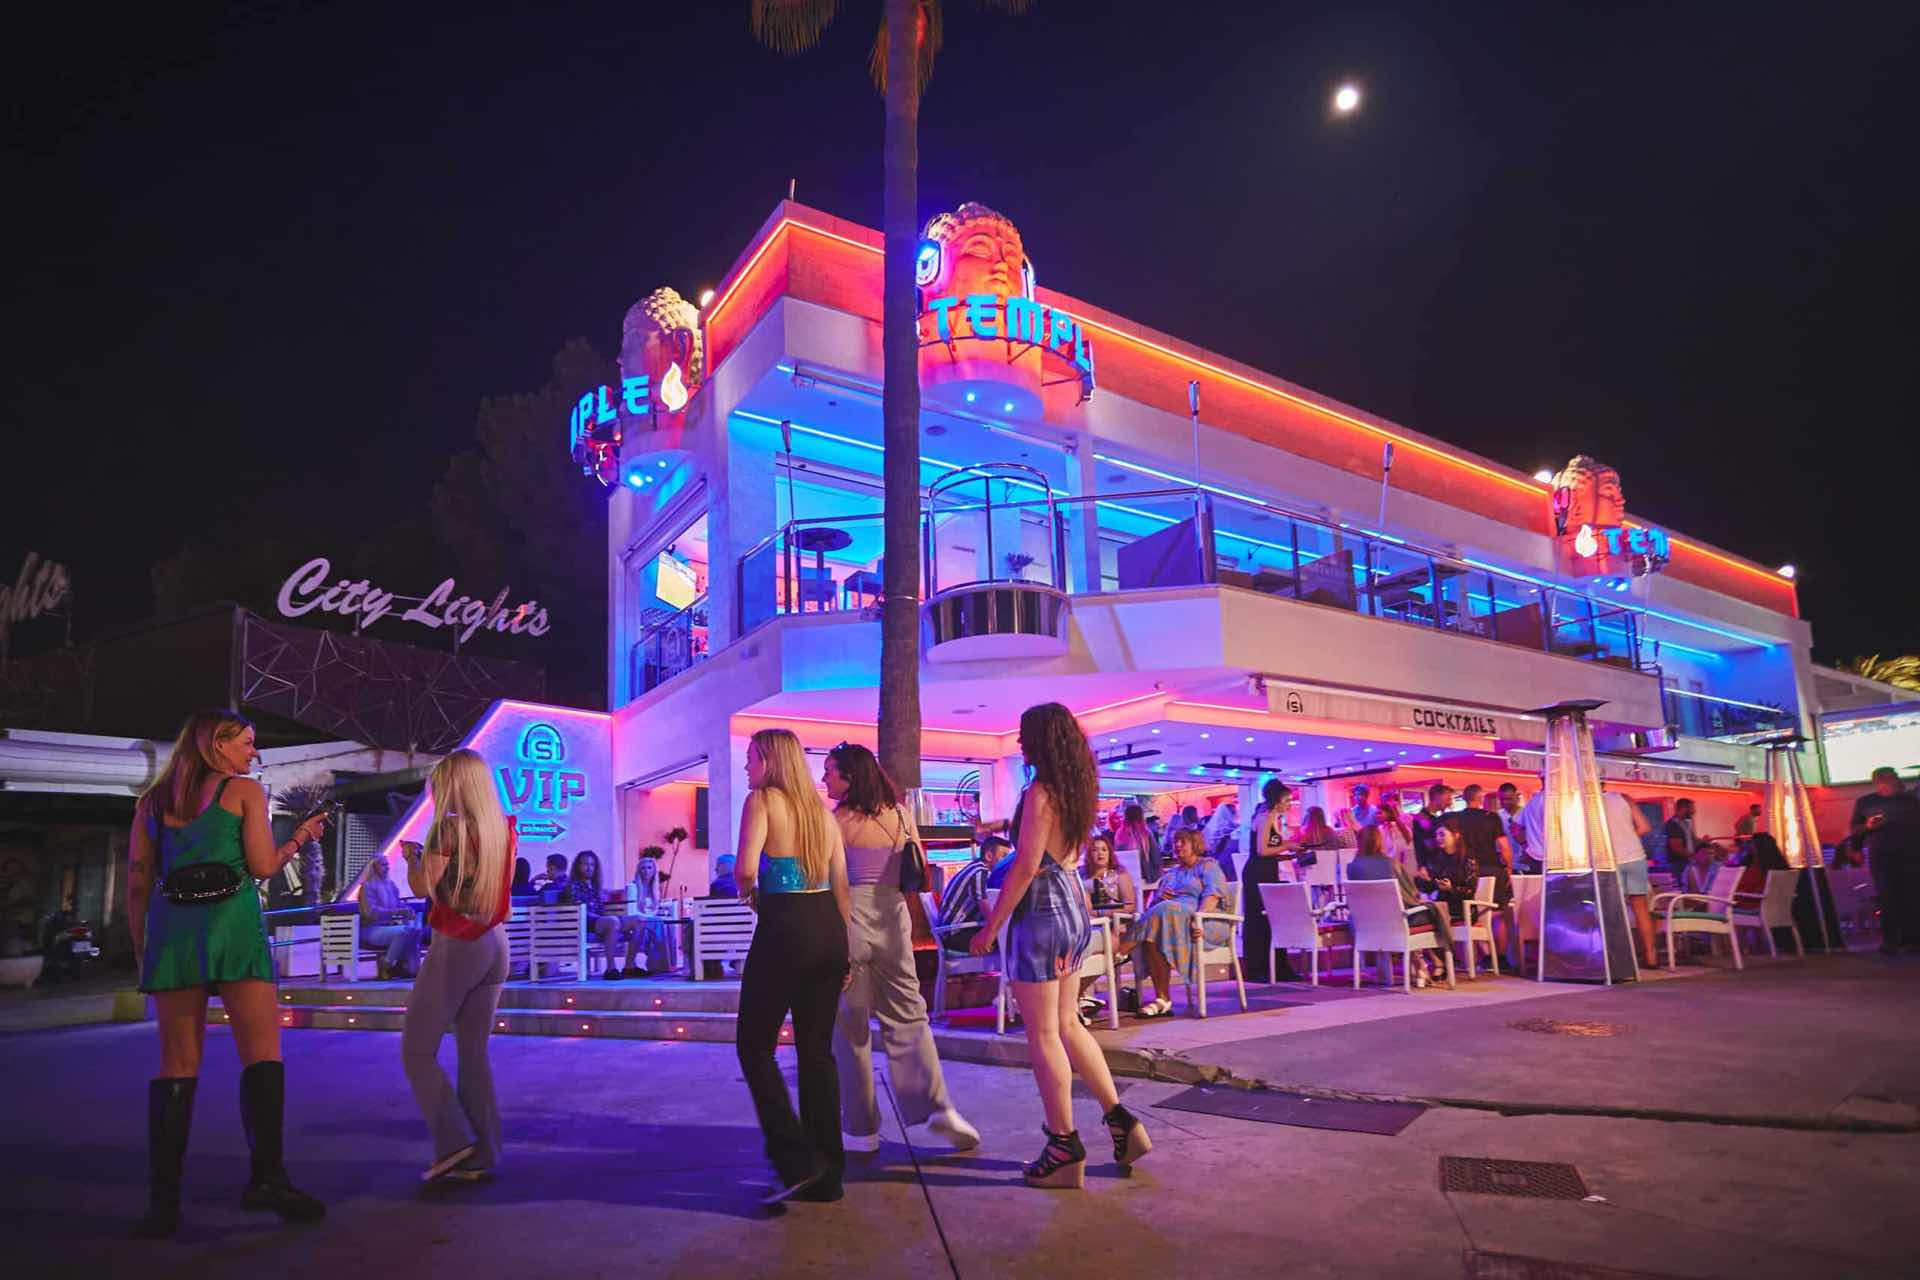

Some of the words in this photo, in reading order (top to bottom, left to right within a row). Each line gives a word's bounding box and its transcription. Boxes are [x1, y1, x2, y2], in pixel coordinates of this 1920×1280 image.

[277, 557, 393, 629] City
[401, 577, 551, 644] Lights
[1413, 708, 1497, 734] COCKTAILS
[499, 766, 586, 812] VIP
